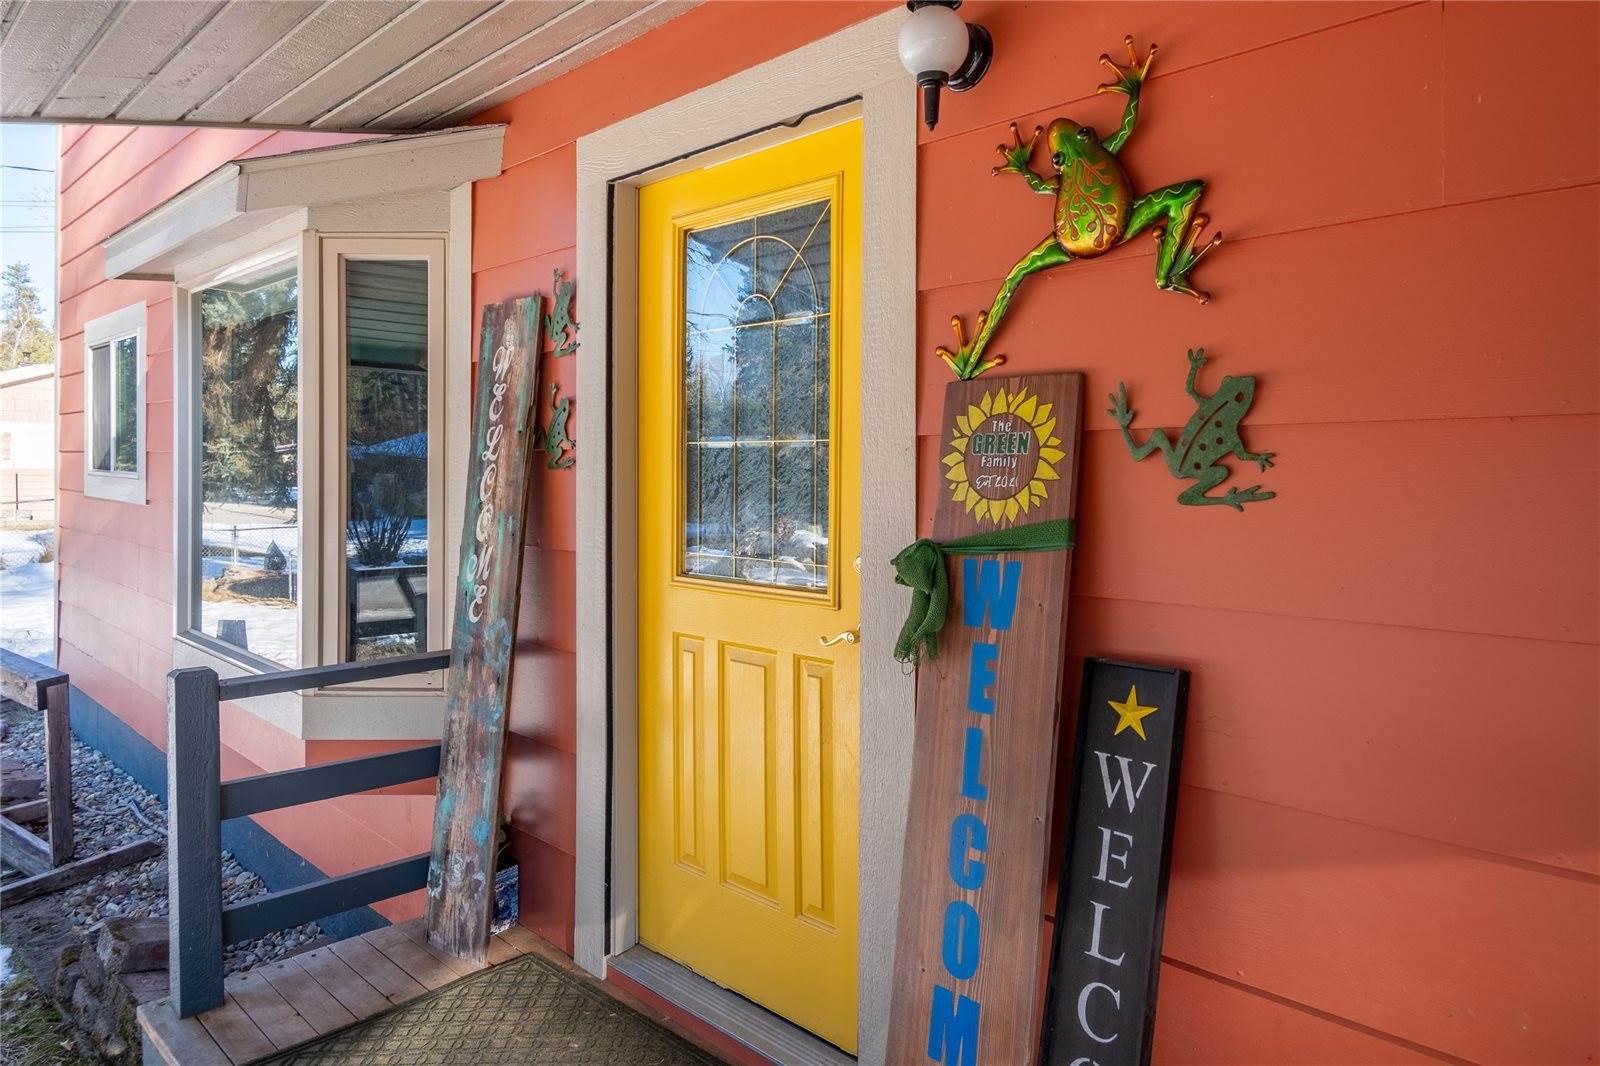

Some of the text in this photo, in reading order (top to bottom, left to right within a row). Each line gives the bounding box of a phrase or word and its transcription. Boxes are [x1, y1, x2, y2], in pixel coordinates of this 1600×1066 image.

[992, 420, 1012, 432] The
[971, 432, 1031, 455] GREEN
[981, 456, 1018, 468] Family
[928, 558, 1022, 1066] WELCOM
[1069, 750, 1157, 1066] WELC
